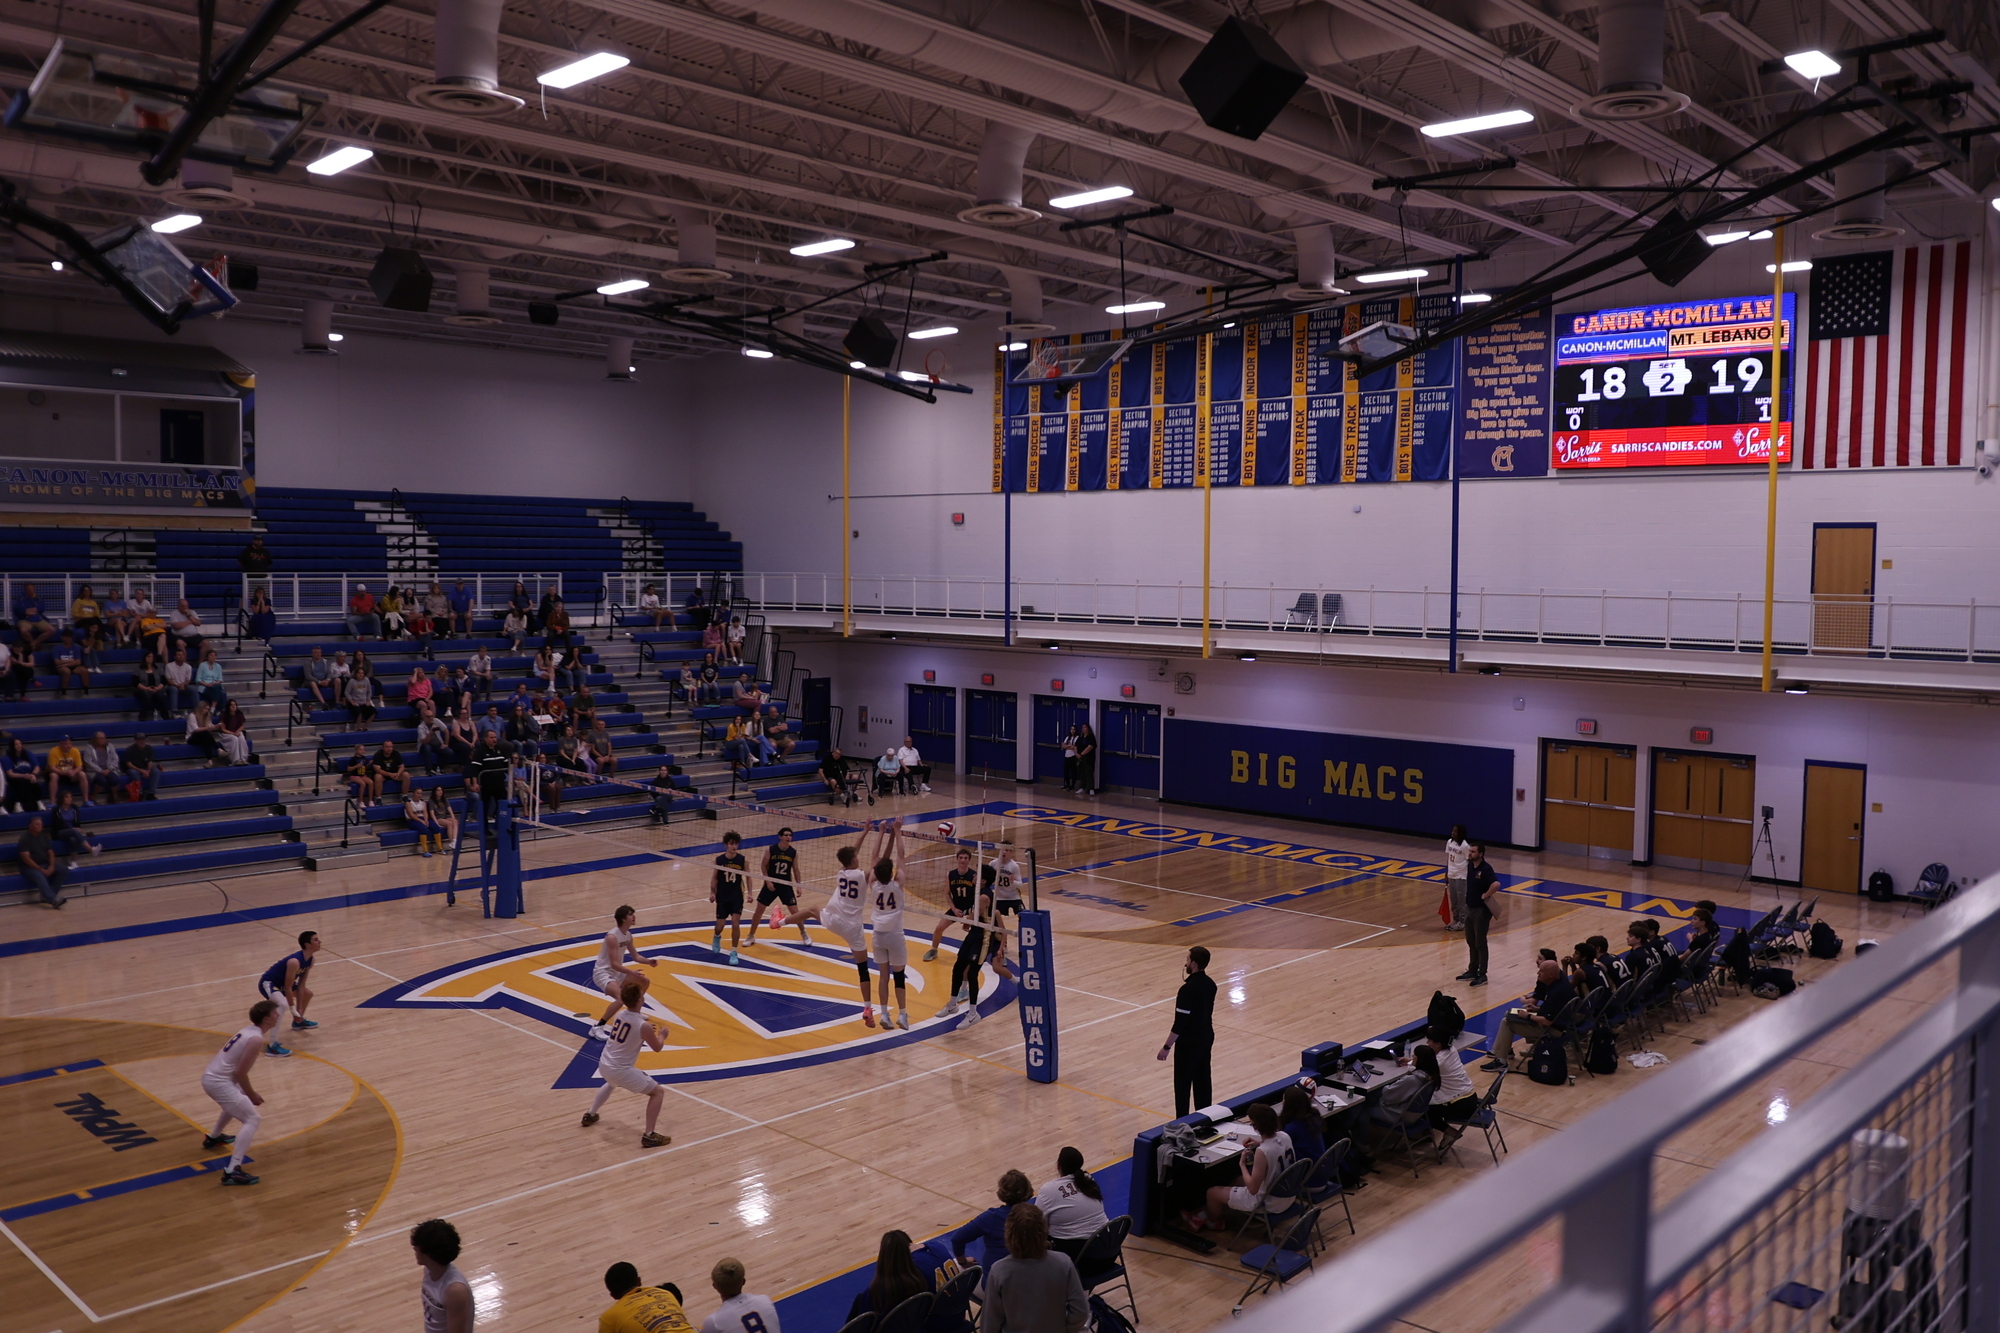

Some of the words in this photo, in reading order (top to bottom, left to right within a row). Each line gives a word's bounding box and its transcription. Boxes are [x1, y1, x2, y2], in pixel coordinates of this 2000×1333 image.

[1366, 303, 1392, 314] SECTION
[1421, 297, 1448, 307] SECTION
[1313, 309, 1338, 320] SECTION
[1416, 308, 1451, 319] CHAMPIONS
[1573, 300, 1773, 334] CANON-MCMILLAN
[1260, 320, 1291, 330] CHAMPIONS
[1309, 319, 1341, 330] CHAMPIONS
[1276, 329, 1291, 338] GIRLS
[1671, 333, 1696, 346] MT.
[1562, 337, 1666, 354] CANON-MCMILLAN
[1295, 326, 1306, 383] BASEBALL
[1246, 357, 1256, 394] INDOOR
[1468, 367, 1481, 377] Our
[1481, 366, 1500, 375] Alma
[1501, 365, 1524, 374] Mater
[1709, 357, 1764, 394] 19
[1111, 372, 1119, 398] BOYS
[1154, 376, 1163, 395] BOYS
[1474, 378, 1483, 387] To
[1484, 378, 1498, 387] you
[1499, 377, 1511, 385] we
[1512, 374, 1526, 384] will
[1527, 374, 1537, 383] be
[1578, 366, 1626, 402] 18
[1660, 373, 1675, 392] 2
[1312, 398, 1337, 409] SECTION
[1364, 395, 1391, 405] SECTION
[1419, 392, 1446, 402] SECTION
[1472, 399, 1488, 408] High
[1489, 398, 1508, 409] upon
[1509, 397, 1522, 405] the
[1169, 408, 1191, 418] SECTION
[1214, 405, 1237, 414] SECTION
[1262, 402, 1286, 412] SECTION
[1308, 409, 1340, 419] CHAMPIONS
[1360, 406, 1394, 416] CHAMPIONS
[1414, 402, 1450, 413] CHAMPIONS
[1466, 410, 1479, 420] Big
[1500, 409, 1512, 417] we
[1513, 407, 1530, 418] give
[1531, 408, 1544, 416] our
[1759, 405, 1771, 422] 1
[1044, 417, 1064, 425] SECTION
[1084, 414, 1104, 424] SECTION
[1125, 411, 1146, 420] SECTION
[1165, 418, 1193, 427] CHAMPIONS
[1211, 414, 1240, 425] CHAMPIONS
[1258, 412, 1289, 422] CHAMPIONS
[1347, 404, 1357, 440] TRACK
[1569, 414, 1581, 430] 0
[1081, 423, 1107, 433] CHAMPIONS
[1122, 420, 1149, 429] CHAMPIONS
[1245, 409, 1255, 448] TENNIS
[1295, 409, 1305, 445] TRACK
[1400, 398, 1411, 448] VOLLEYBALL
[1481, 420, 1497, 429] love
[1498, 419, 1506, 428] to
[1041, 426, 1066, 435] CHAMPIONS
[1071, 418, 1079, 452] TENNIS
[1111, 415, 1119, 459] VOLLEYBALL
[1465, 431, 1476, 440] All
[1477, 430, 1505, 440] through
[1506, 429, 1519, 438] the
[994, 423, 1002, 462] SOCCER
[1031, 420, 1039, 457] SOCCER
[1153, 420, 1163, 478] WRESTLING
[1561, 434, 1602, 463] Sarris
[1611, 440, 1723, 454] SARRISCANDIES.COM
[1244, 451, 1253, 479] BOYS
[1295, 449, 1304, 477] BOYS
[1345, 445, 1355, 476] GIRLS
[1400, 453, 1409, 474] BOYS
[1030, 461, 1038, 488] GIRLS
[1110, 464, 1118, 484] GIRLS
[8, 485, 61, 495] HOME
[72, 485, 93, 496] OF
[102, 488, 135, 497] THE
[145, 489, 172, 499] BIG
[182, 490, 225, 501] MACS
[1580, 722, 1593, 732] EXIT
[1695, 731, 1709, 741] EXIT
[1230, 750, 1296, 790] BIG
[1323, 759, 1424, 805] MACS
[774, 862, 788, 875] 12
[724, 871, 737, 884] 14
[839, 878, 859, 899] 26
[956, 887, 967, 898] 11
[876, 892, 896, 911] 44
[1050, 888, 1149, 912] WPIAL
[1022, 927, 1041, 991] BIG
[610, 1019, 631, 1044] 20
[1025, 1005, 1044, 1068] MAC
[222, 1033, 242, 1053] 8
[54, 1092, 158, 1152] WPIAL
